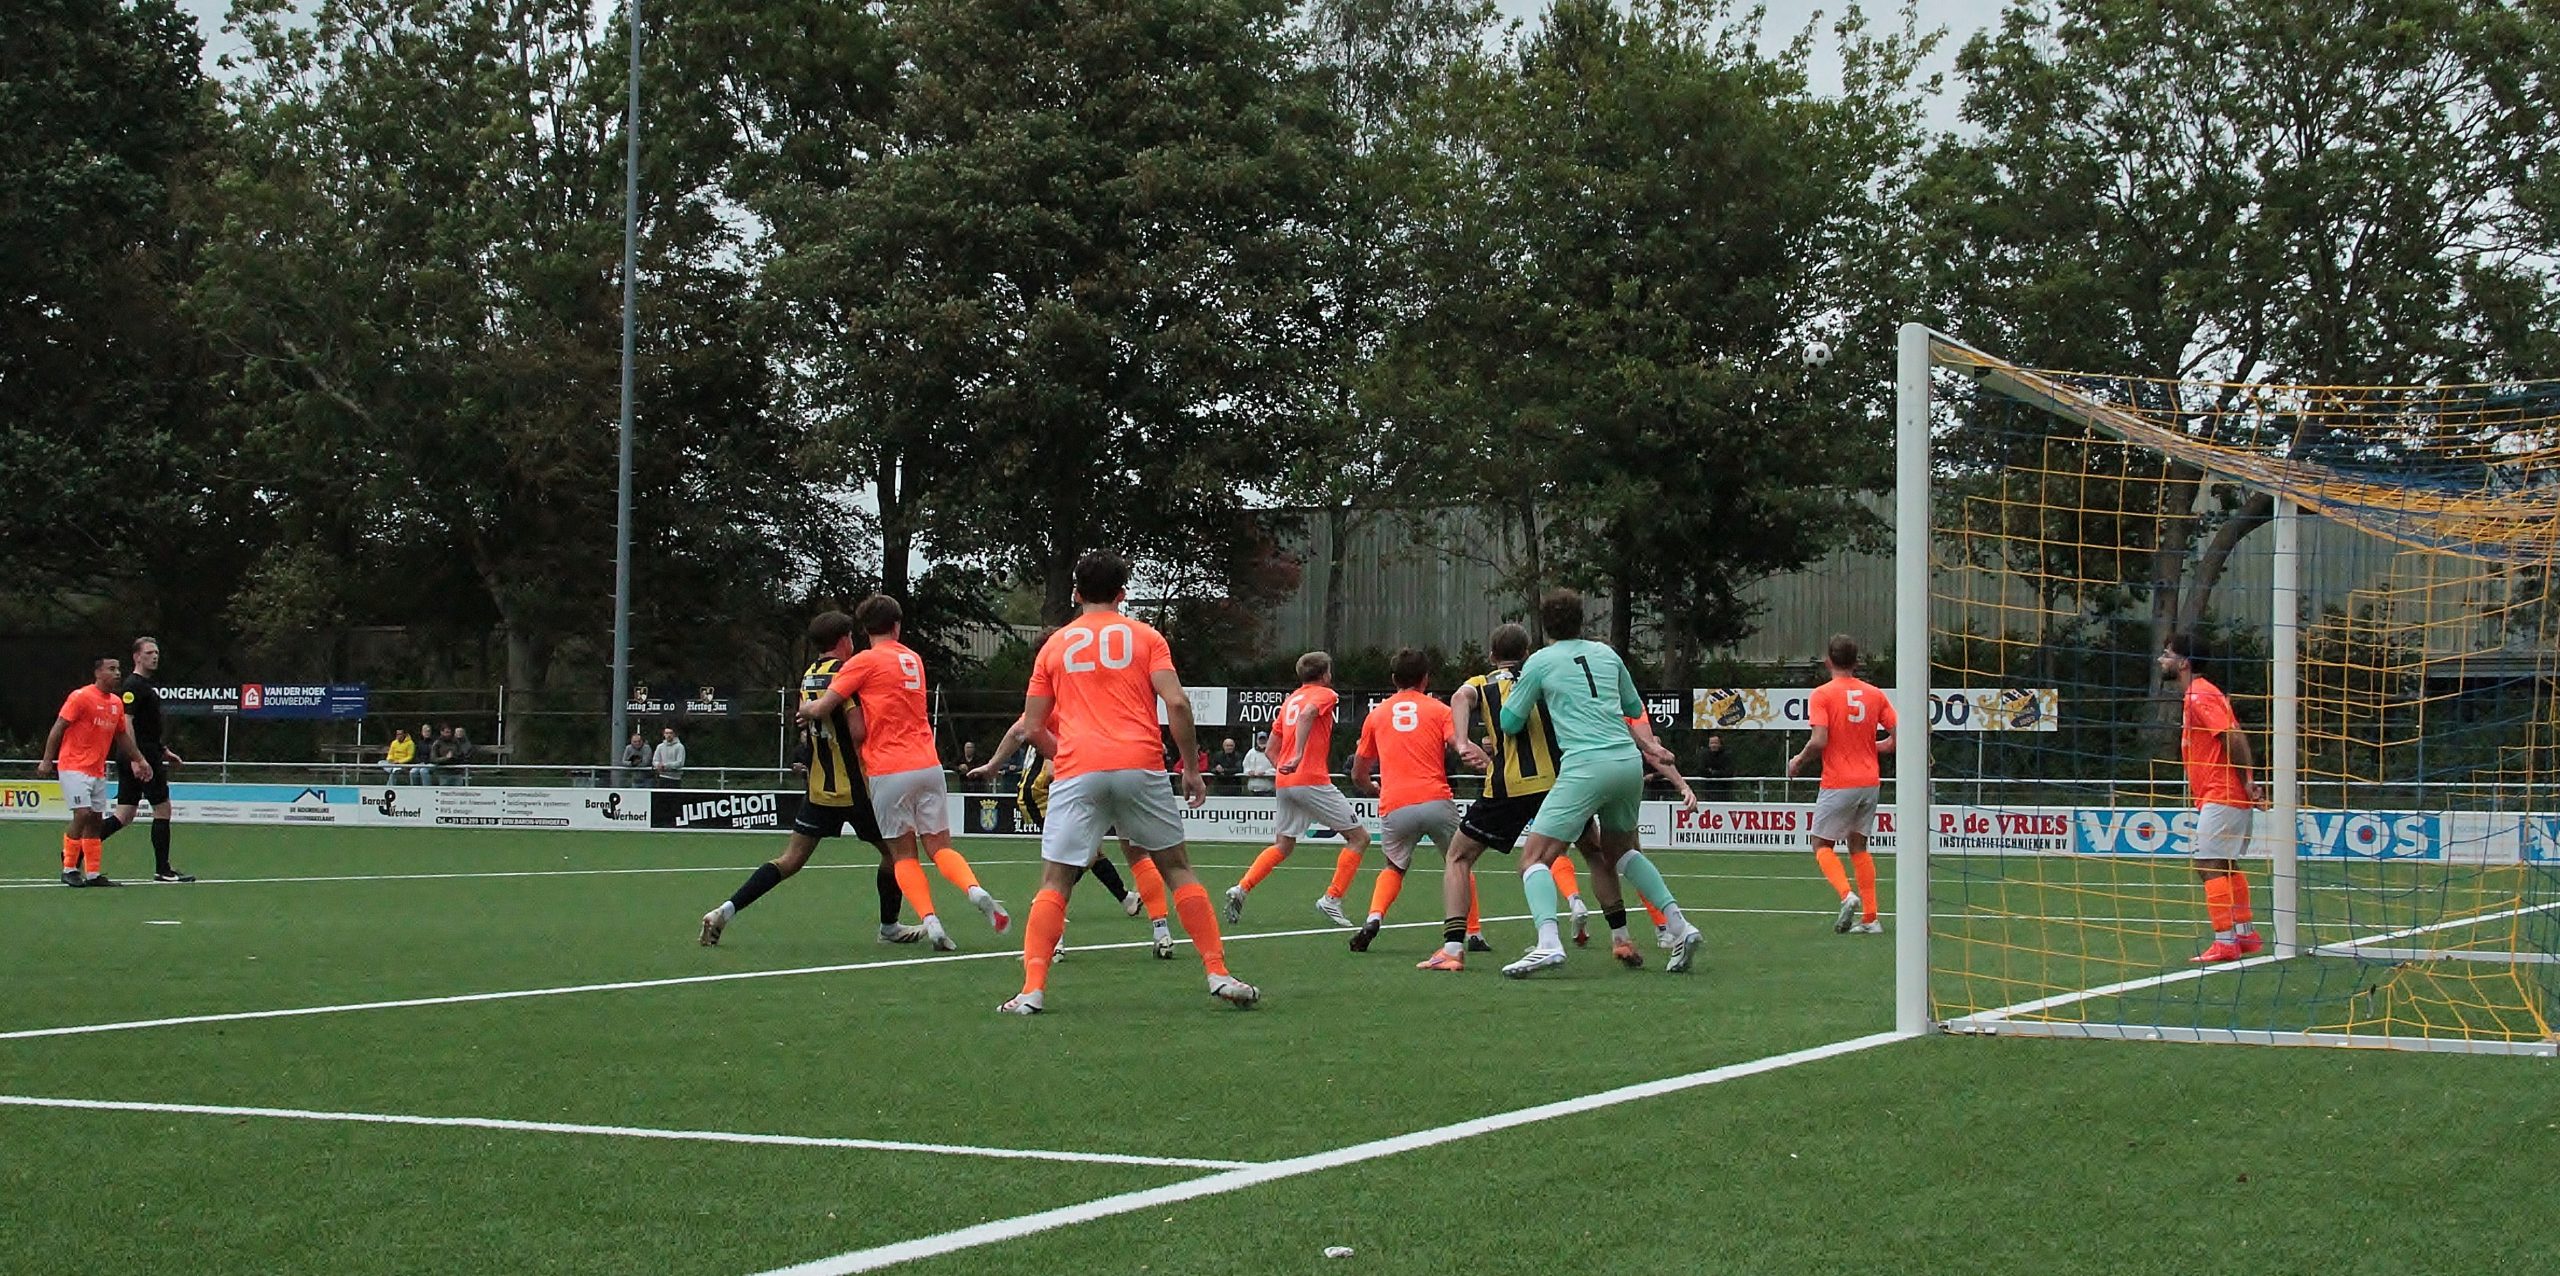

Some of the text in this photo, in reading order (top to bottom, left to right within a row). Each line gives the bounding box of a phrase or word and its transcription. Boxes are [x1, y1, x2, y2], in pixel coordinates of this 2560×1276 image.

[1063, 623, 1132, 673] 20
[898, 653, 920, 689] 9
[1573, 655, 1598, 698] 1
[264, 687, 282, 696] VAN
[284, 687, 300, 696] DER
[302, 687, 326, 696] HOEK
[1240, 692, 1282, 703] DE BOER
[264, 697, 321, 706] BOUWBEDRIJF
[663, 703, 675, 711] 0.0
[687, 701, 712, 712] Hertog
[1847, 690, 1865, 723] 5
[1285, 694, 1304, 727] 6
[1392, 702, 1418, 732] 8
[1647, 699, 1679, 728] tzjill
[0, 790, 40, 807] EVO
[362, 796, 387, 805] Baron
[585, 799, 610, 808] Baron
[613, 810, 647, 821] Verhoef
[732, 812, 777, 829] signing
[1676, 810, 1692, 829] P.
[1699, 809, 1722, 829] de
[1729, 811, 1796, 831] VRIES
[1940, 814, 2067, 836] P. de VRIES
[2080, 812, 2199, 852] VOS
[1676, 832, 1780, 845] INSTALLATIETECHNIEKEN
[1785, 834, 1796, 845] BV
[2056, 838, 2067, 850] BV
[2300, 814, 2428, 857] VOS
